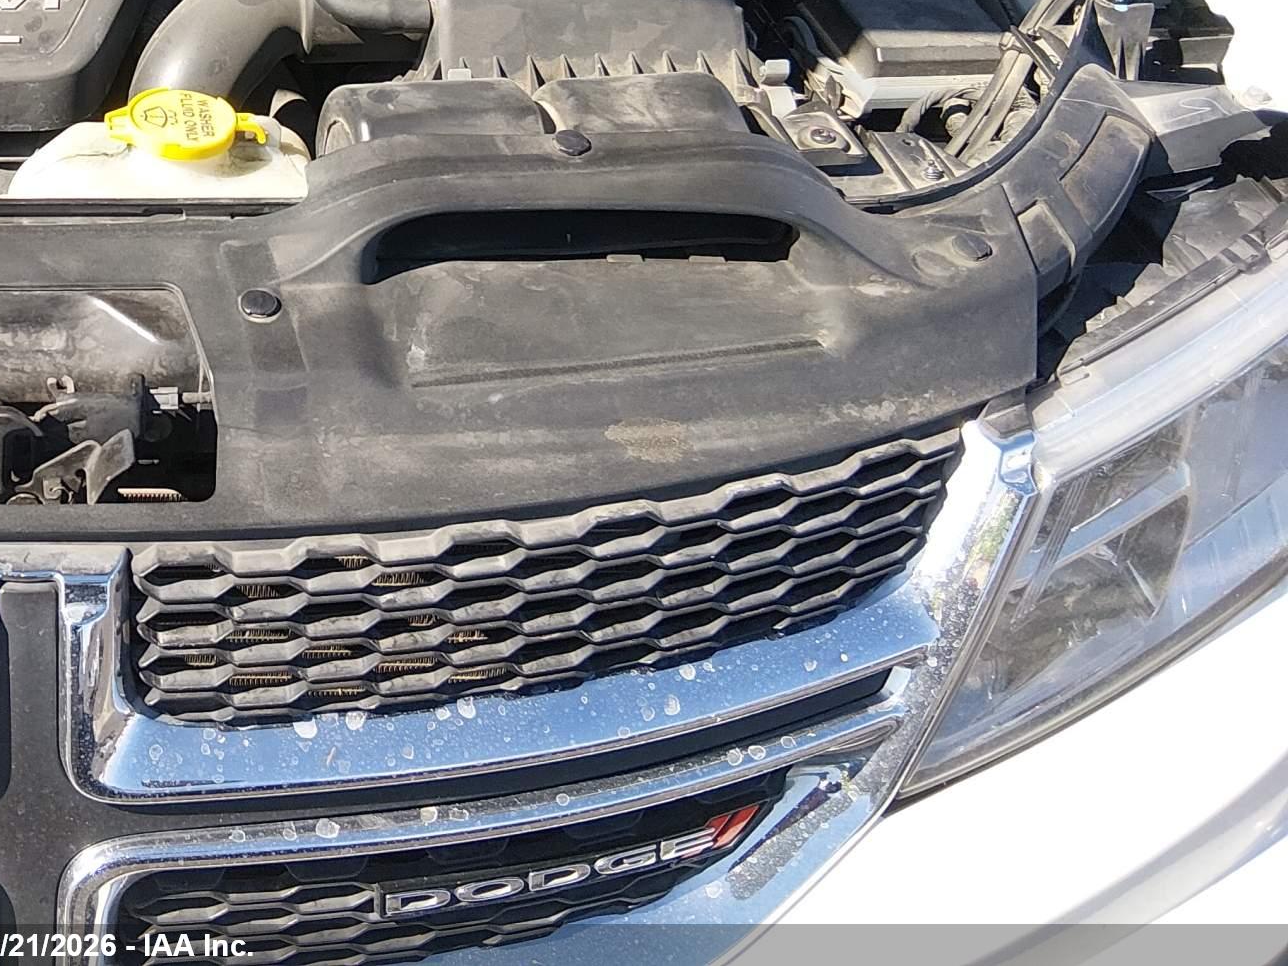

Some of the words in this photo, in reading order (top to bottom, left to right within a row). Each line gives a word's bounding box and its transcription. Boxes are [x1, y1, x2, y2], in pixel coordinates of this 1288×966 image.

[179, 92, 195, 117] FLUID
[197, 99, 215, 137] WASHER
[184, 120, 199, 142] ONLY
[385, 828, 716, 916] DODGE
